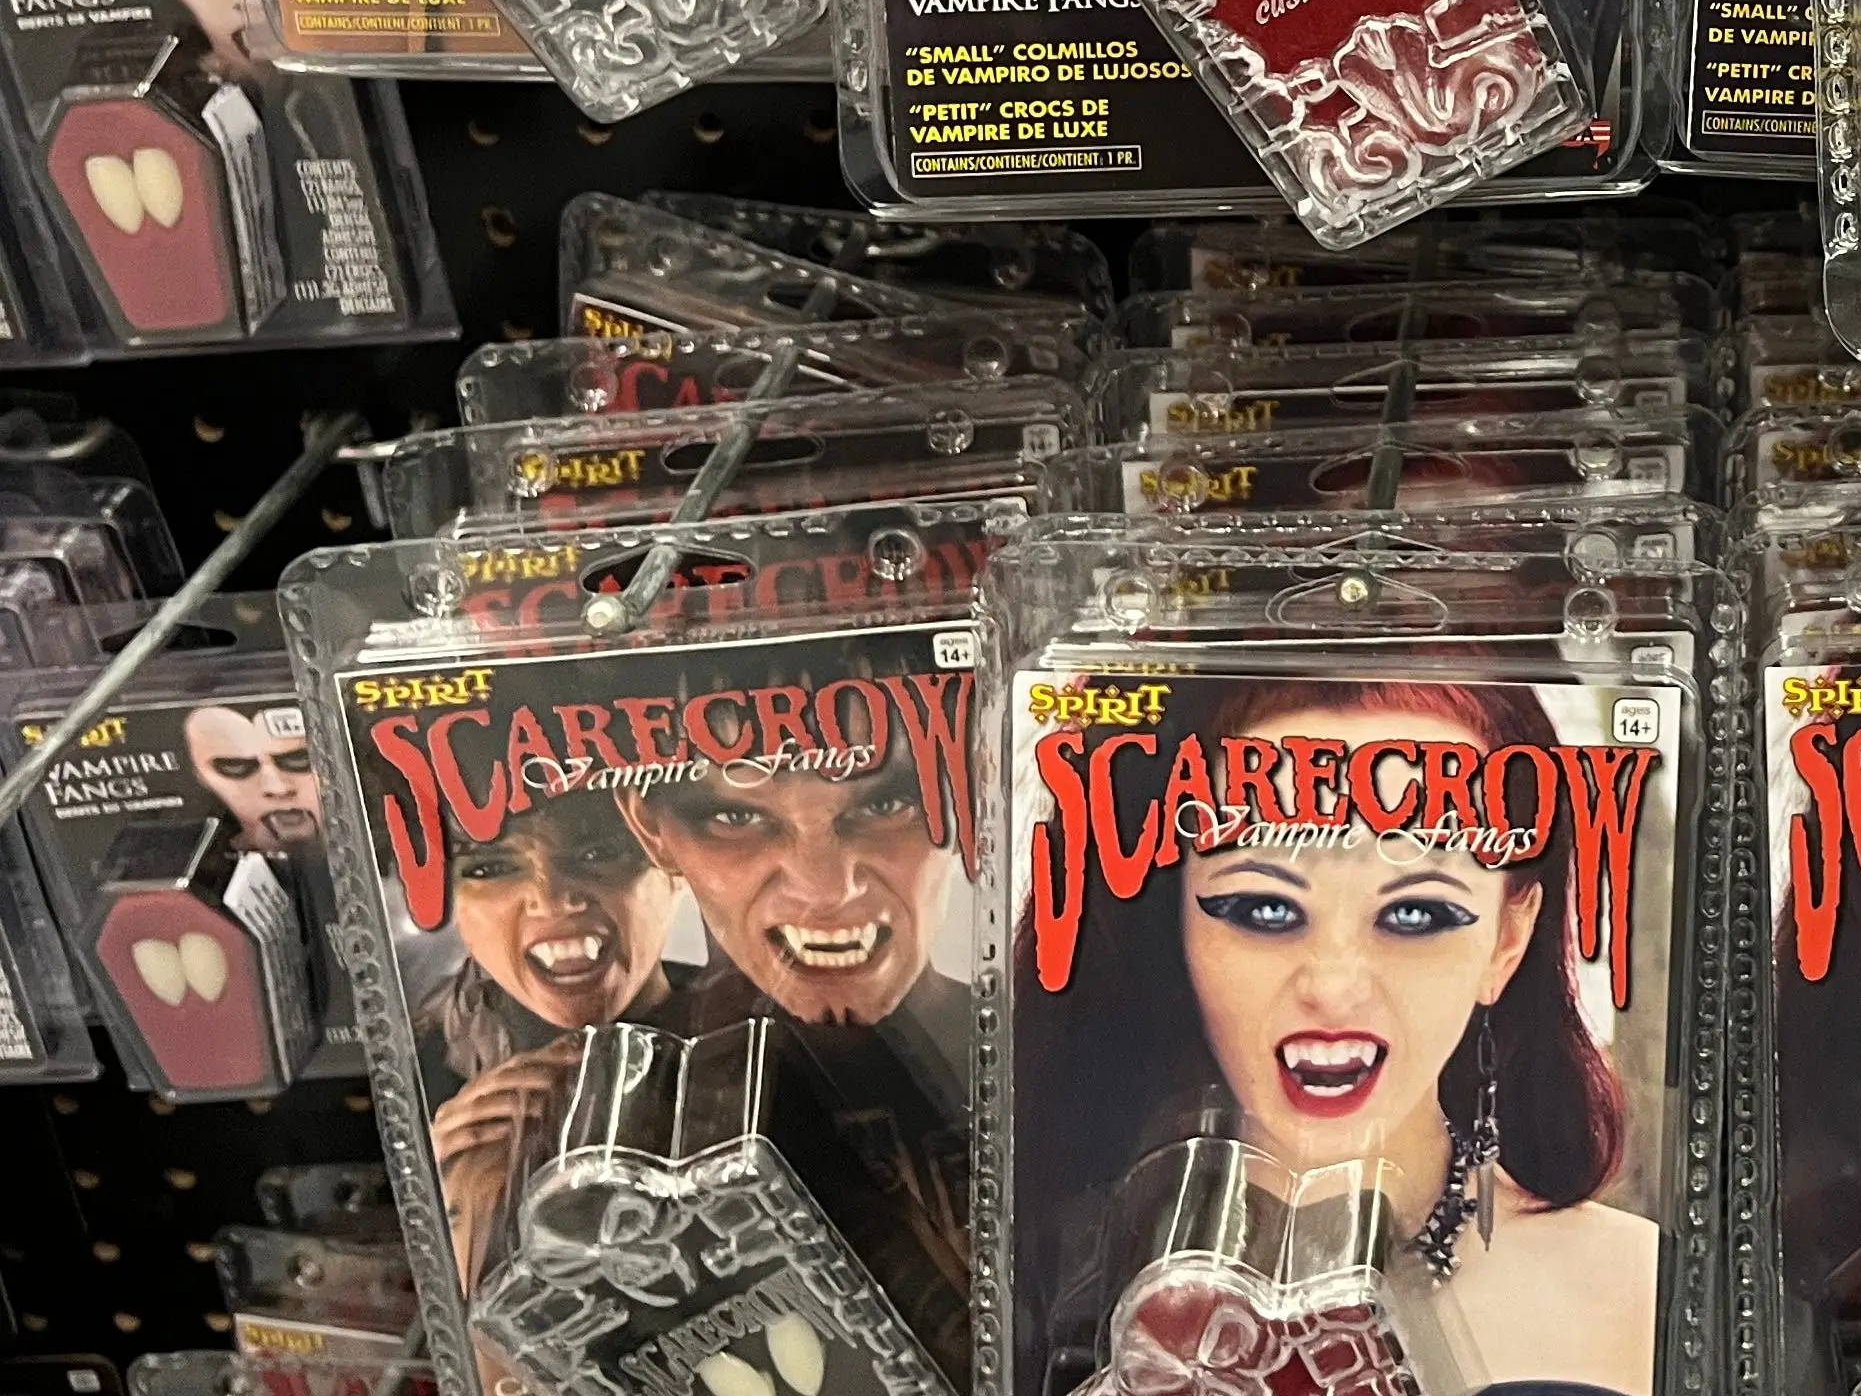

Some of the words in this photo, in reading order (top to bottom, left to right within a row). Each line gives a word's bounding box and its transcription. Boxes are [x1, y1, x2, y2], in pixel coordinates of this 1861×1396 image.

[1708, 28, 1734, 44] DE
[1013, 41, 1138, 61] COLMILLOS
[907, 68, 936, 86] DE
[942, 66, 1051, 85] VAMPIRO
[1057, 64, 1085, 81] DE
[1093, 61, 1192, 80] LUJOSOS
[1704, 87, 1795, 105] VAMPIRE
[999, 100, 1075, 118] CROCS
[1082, 99, 1109, 116] DE
[909, 123, 1010, 143] VAMPIRE
[1018, 122, 1045, 140] DE
[1053, 120, 1108, 138] LUXE
[1107, 151, 1113, 166] 1
[940, 649, 970, 665] 14+
[354, 668, 493, 711] SPIRIT
[1029, 682, 1171, 726] SPIRIT
[1621, 704, 1651, 718] ages
[1619, 718, 1653, 737] 14+
[521, 756, 710, 801] Vampire
[722, 738, 876, 789] Fangs
[371, 672, 977, 930] SCARECROW
[1174, 799, 1363, 867] Vampire
[1376, 810, 1537, 868] Fangs
[1033, 730, 1661, 1012] SCARECROW
